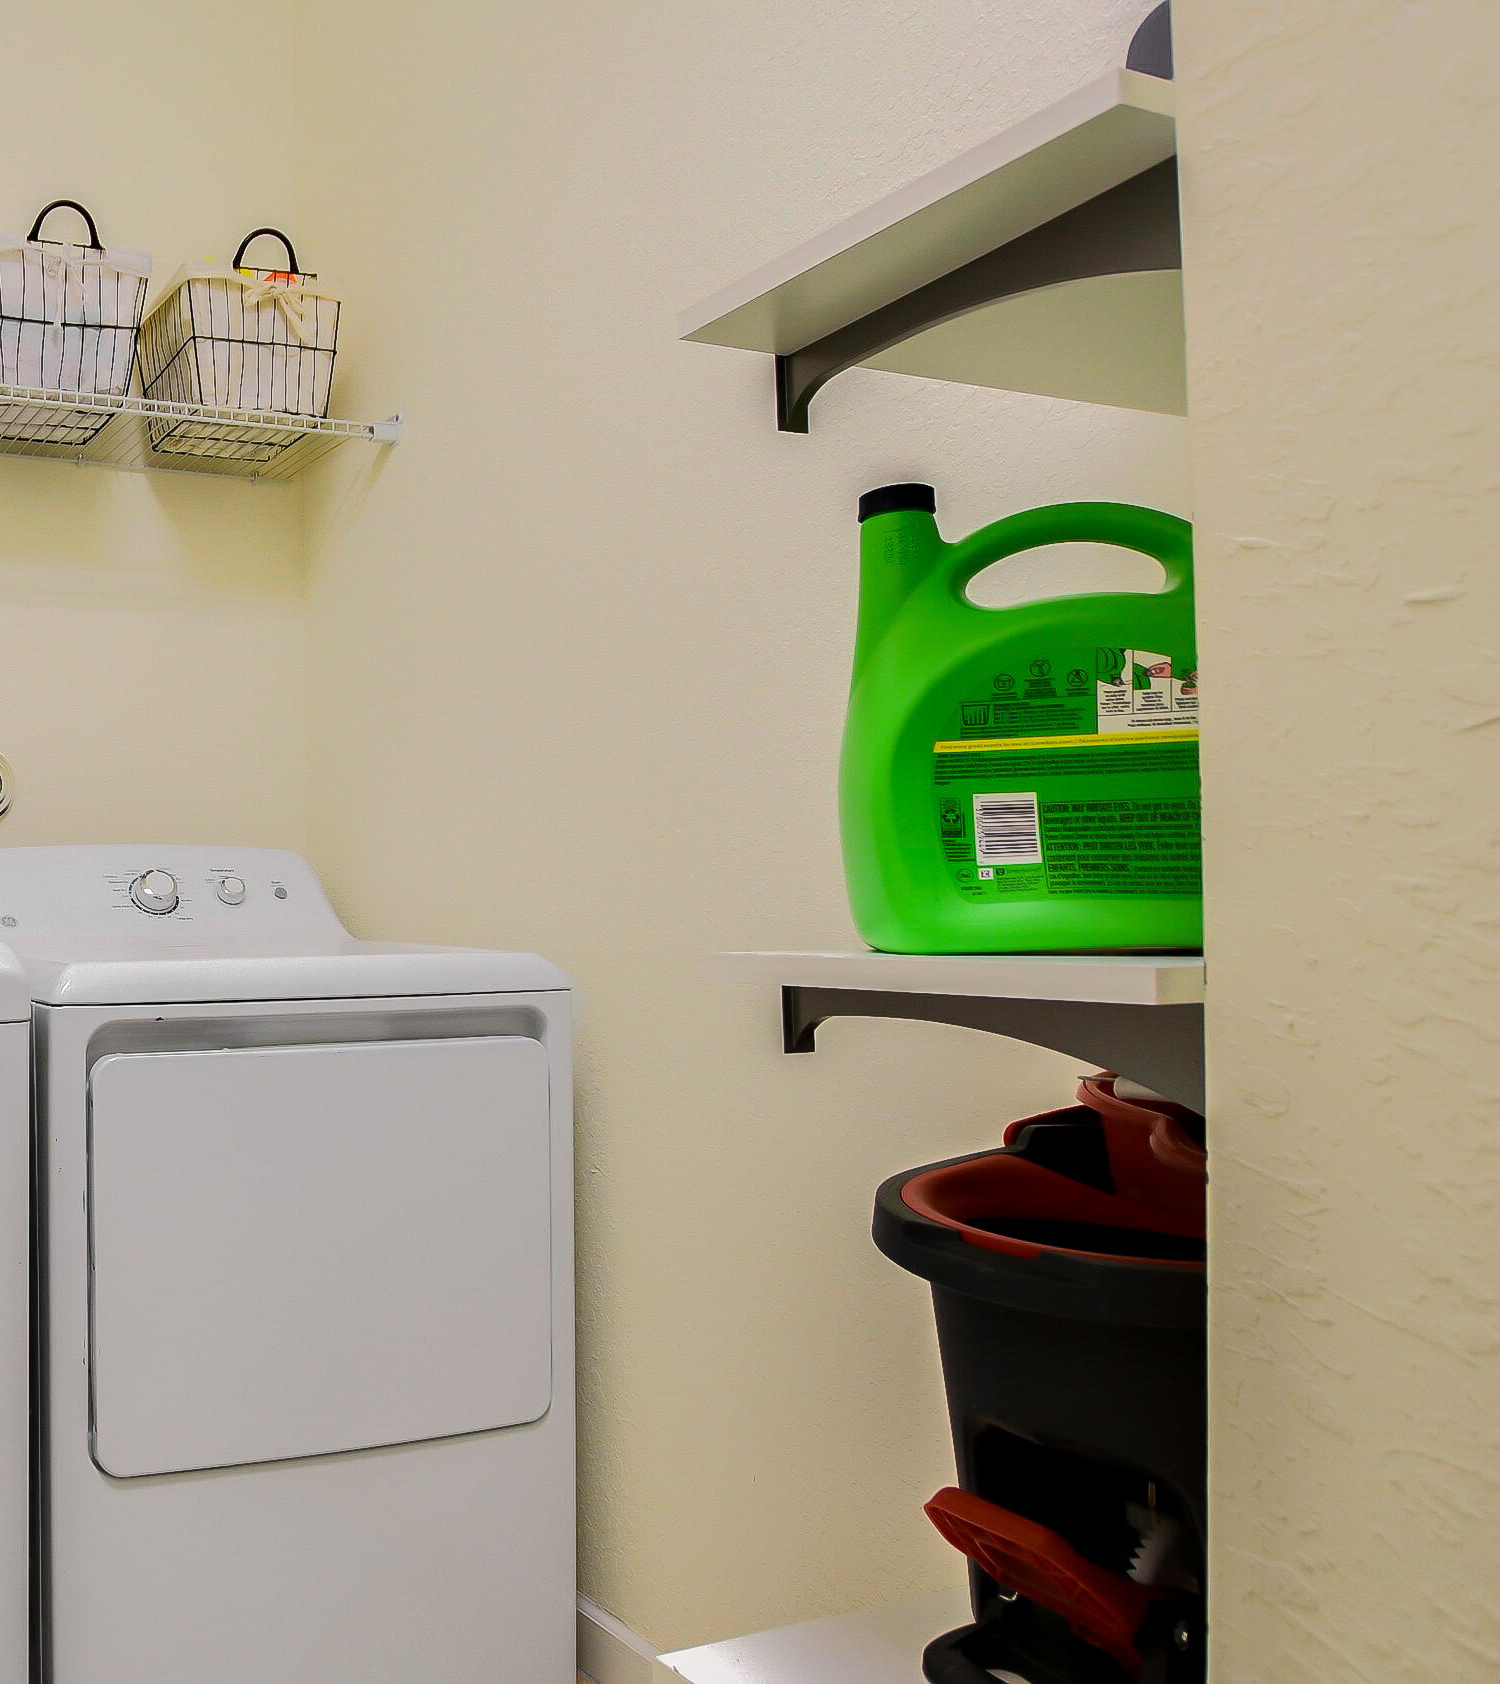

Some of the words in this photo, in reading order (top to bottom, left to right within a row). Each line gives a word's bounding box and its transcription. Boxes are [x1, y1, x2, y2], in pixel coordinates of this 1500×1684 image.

[1070, 803, 1085, 813] MAY
[1086, 802, 1113, 812] IRRITATE
[1114, 802, 1131, 811] EYES.
[1119, 813, 1135, 823] KEEP
[1136, 812, 1149, 822] OUT
[1083, 842, 1098, 851] PEUT
[1099, 841, 1124, 851] IRRITER
[1125, 841, 1136, 851] LES
[1078, 863, 1109, 872] PREMIERS
